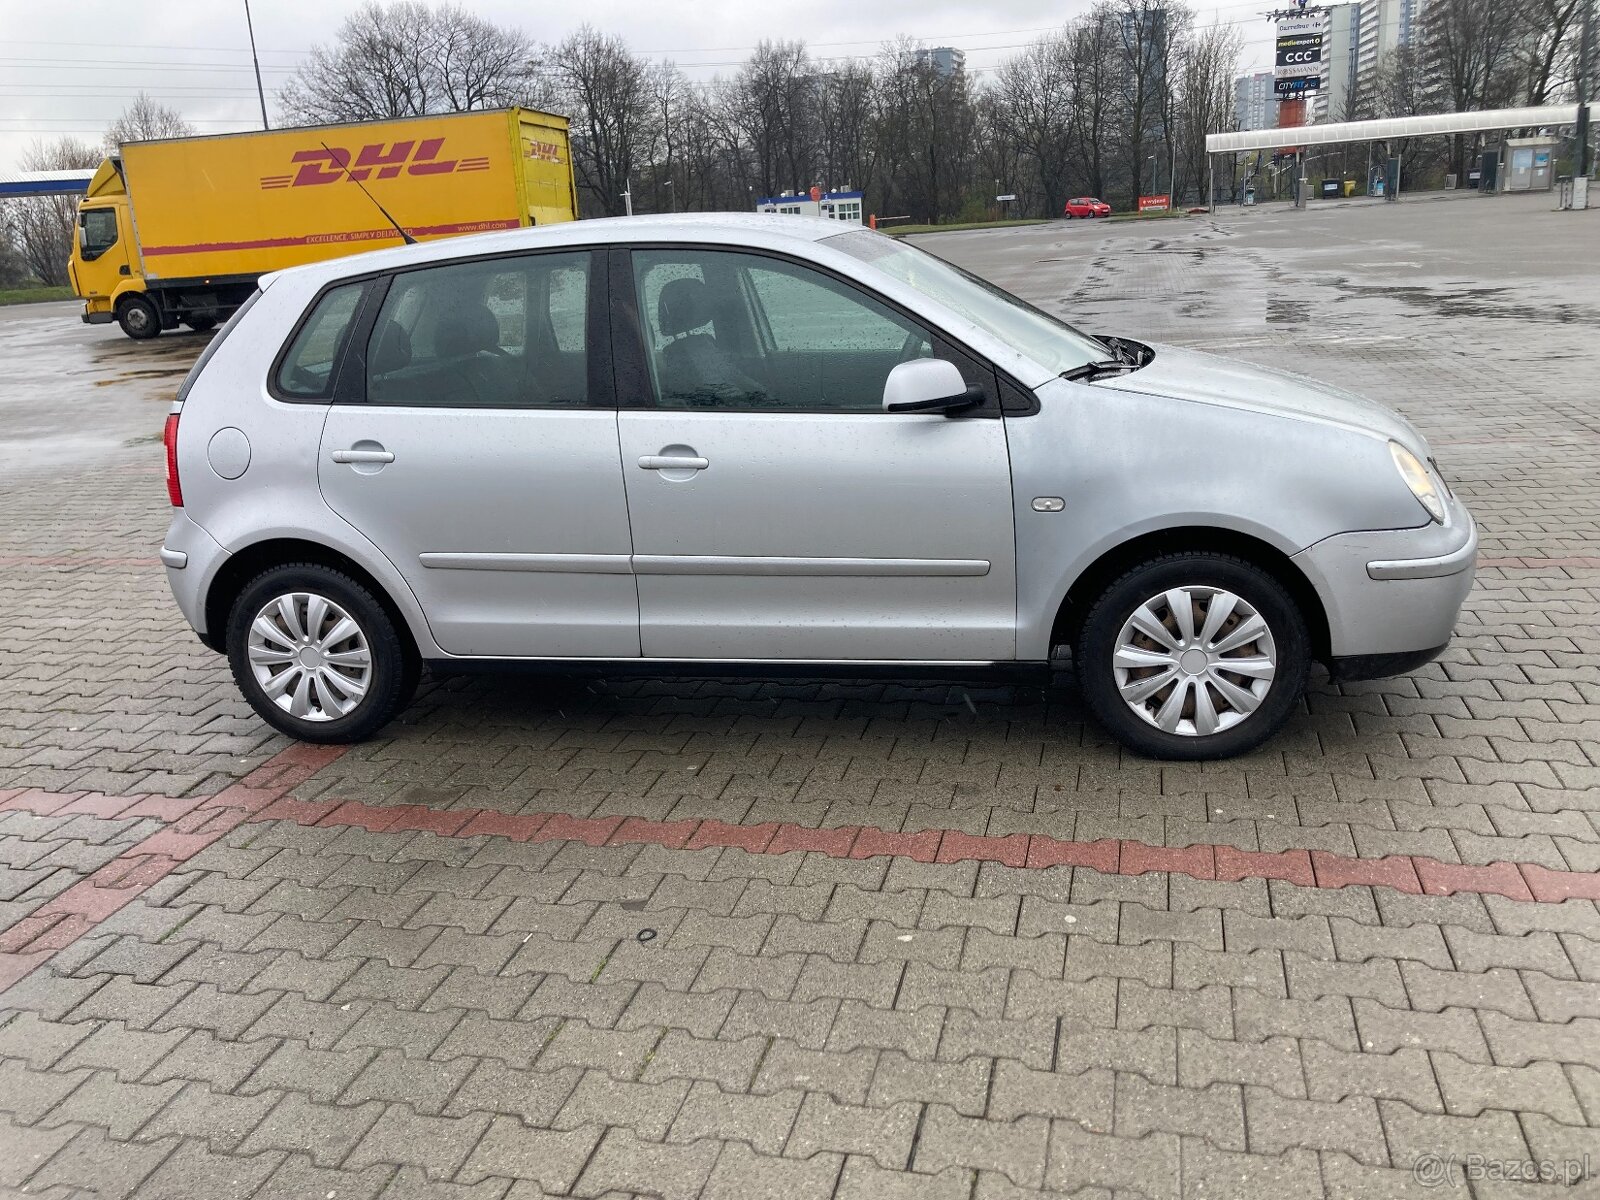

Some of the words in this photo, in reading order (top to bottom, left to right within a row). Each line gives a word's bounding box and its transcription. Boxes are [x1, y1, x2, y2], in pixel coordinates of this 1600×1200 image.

[1278, 39, 1315, 47] mediaexpert
[1285, 51, 1312, 63] CCC
[1278, 81, 1305, 90] CITYFIT
[530, 141, 561, 163] DHL
[291, 137, 459, 188] DHL
[457, 221, 507, 232] www.dhl.com
[350, 231, 375, 240] SIMPLY
